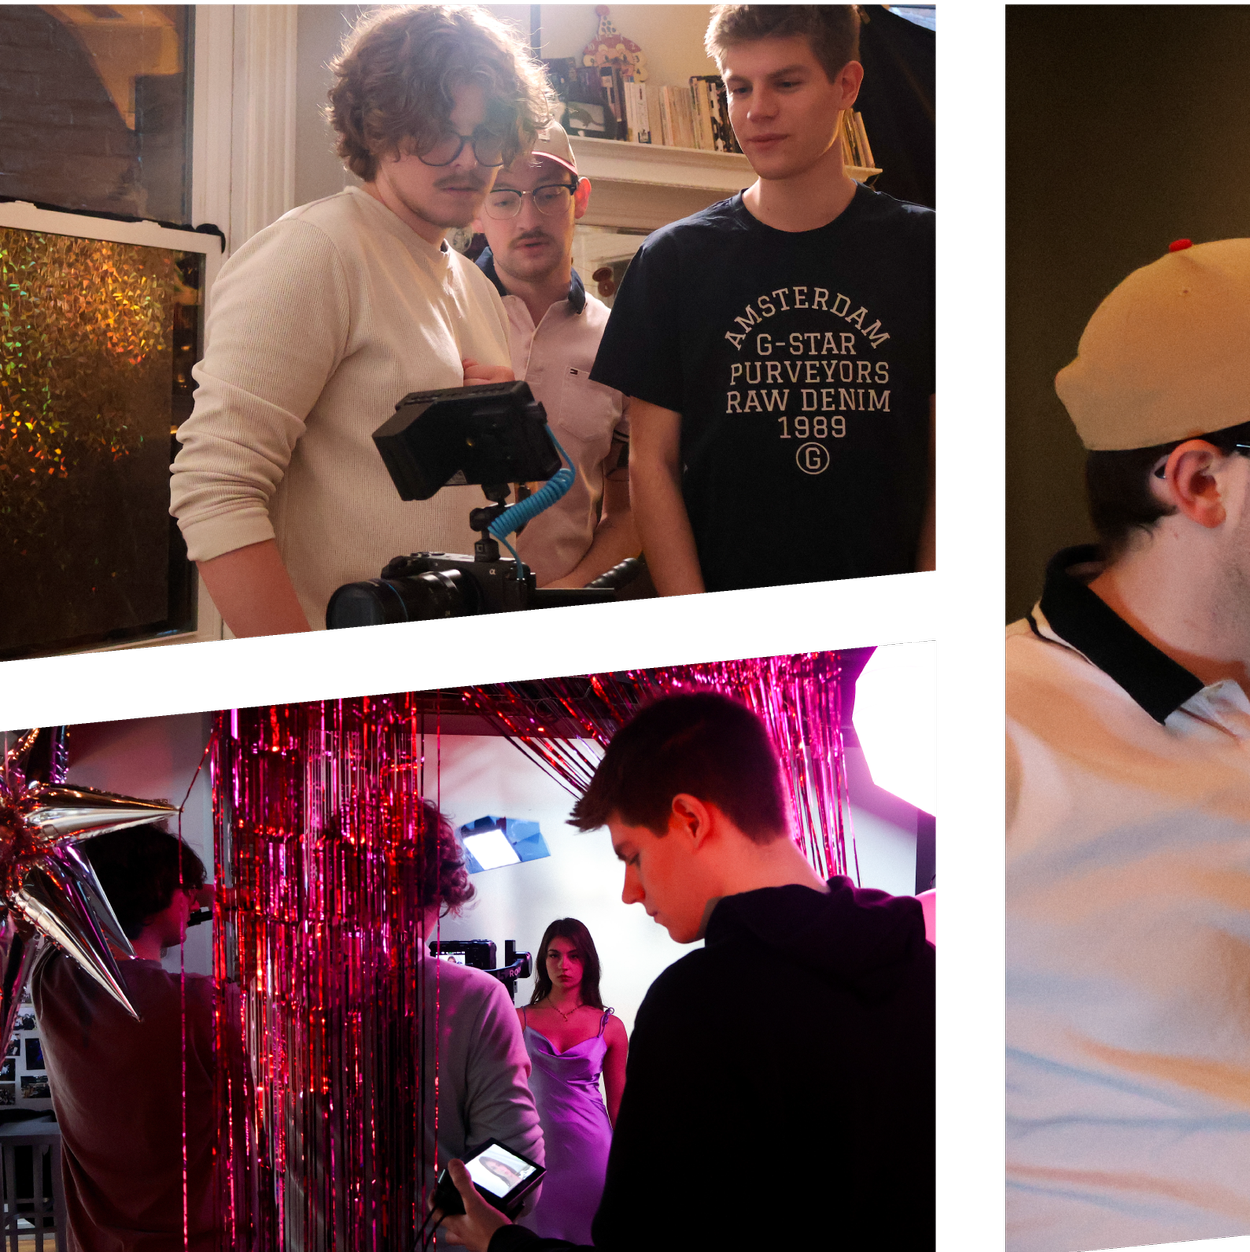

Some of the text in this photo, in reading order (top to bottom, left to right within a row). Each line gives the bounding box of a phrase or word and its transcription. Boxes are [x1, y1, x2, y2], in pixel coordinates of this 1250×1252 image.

[724, 286, 890, 350] AMSTERDAM
[756, 332, 856, 356] G-STAR
[730, 360, 889, 386] PURVEYORS
[726, 388, 891, 413] RAW DENIM
[777, 416, 847, 439] 1989
[805, 447, 821, 470] G
